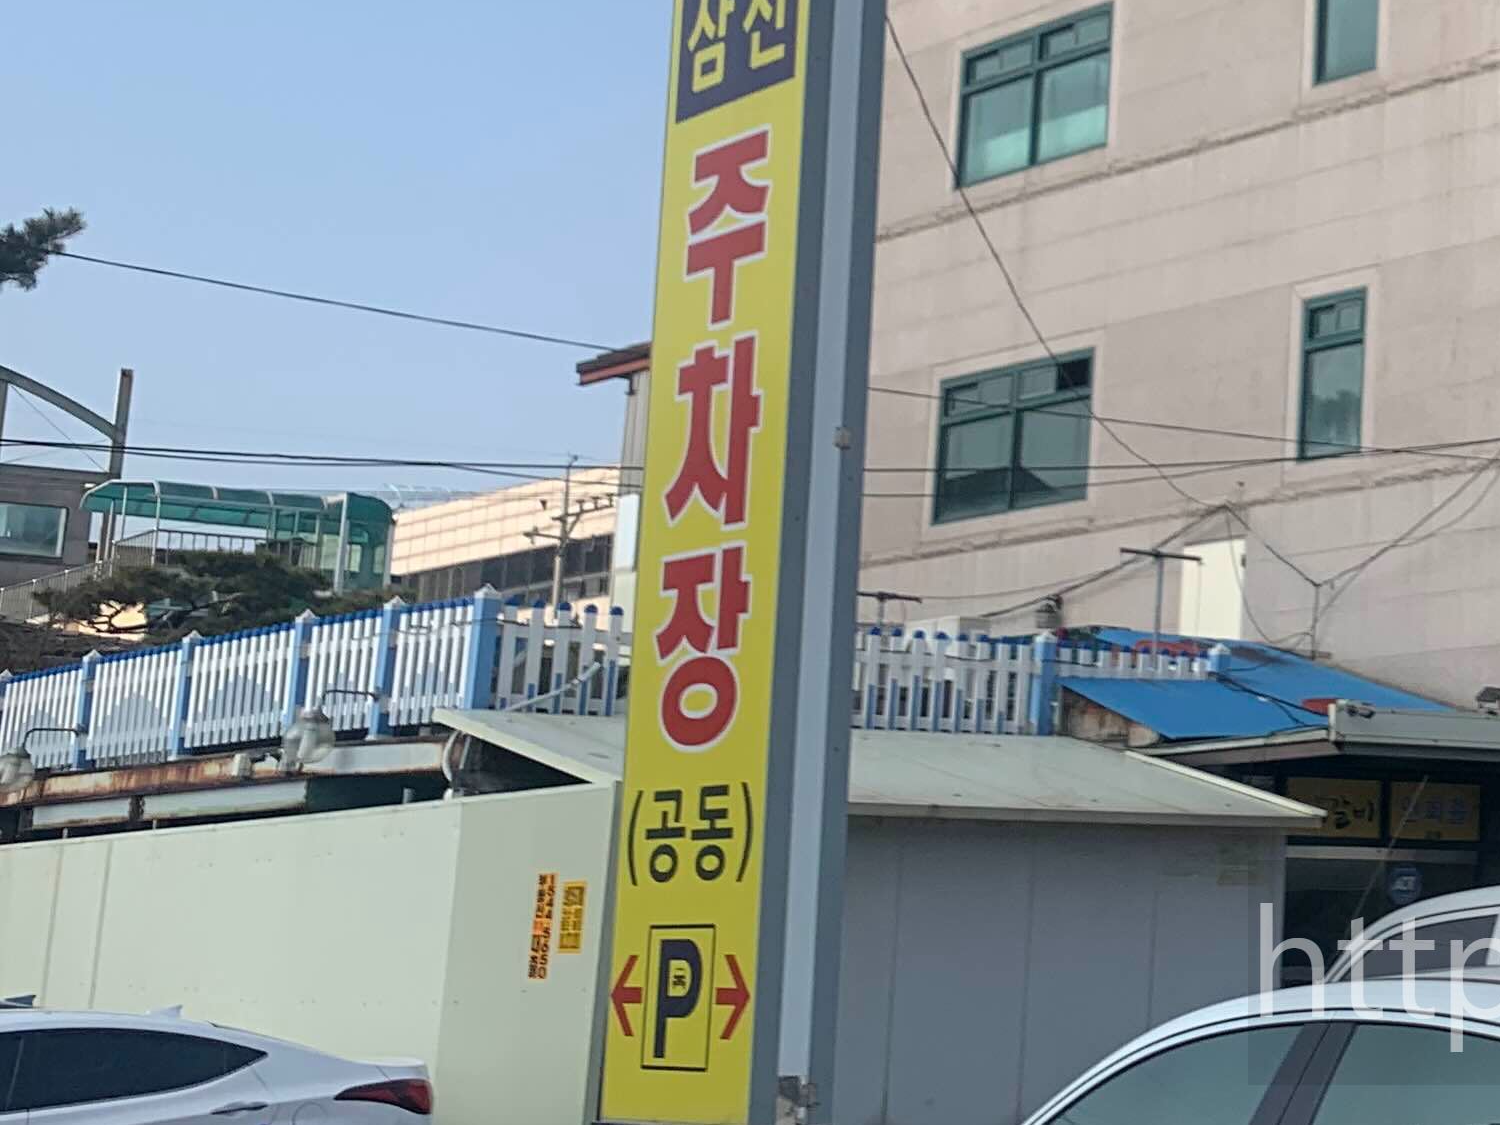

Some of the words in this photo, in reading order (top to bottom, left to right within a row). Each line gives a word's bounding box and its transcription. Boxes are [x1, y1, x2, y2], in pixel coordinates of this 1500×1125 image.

[656, 127, 771, 748] 주차장
[628, 781, 753, 887] (공동)
[653, 938, 703, 1059] P
